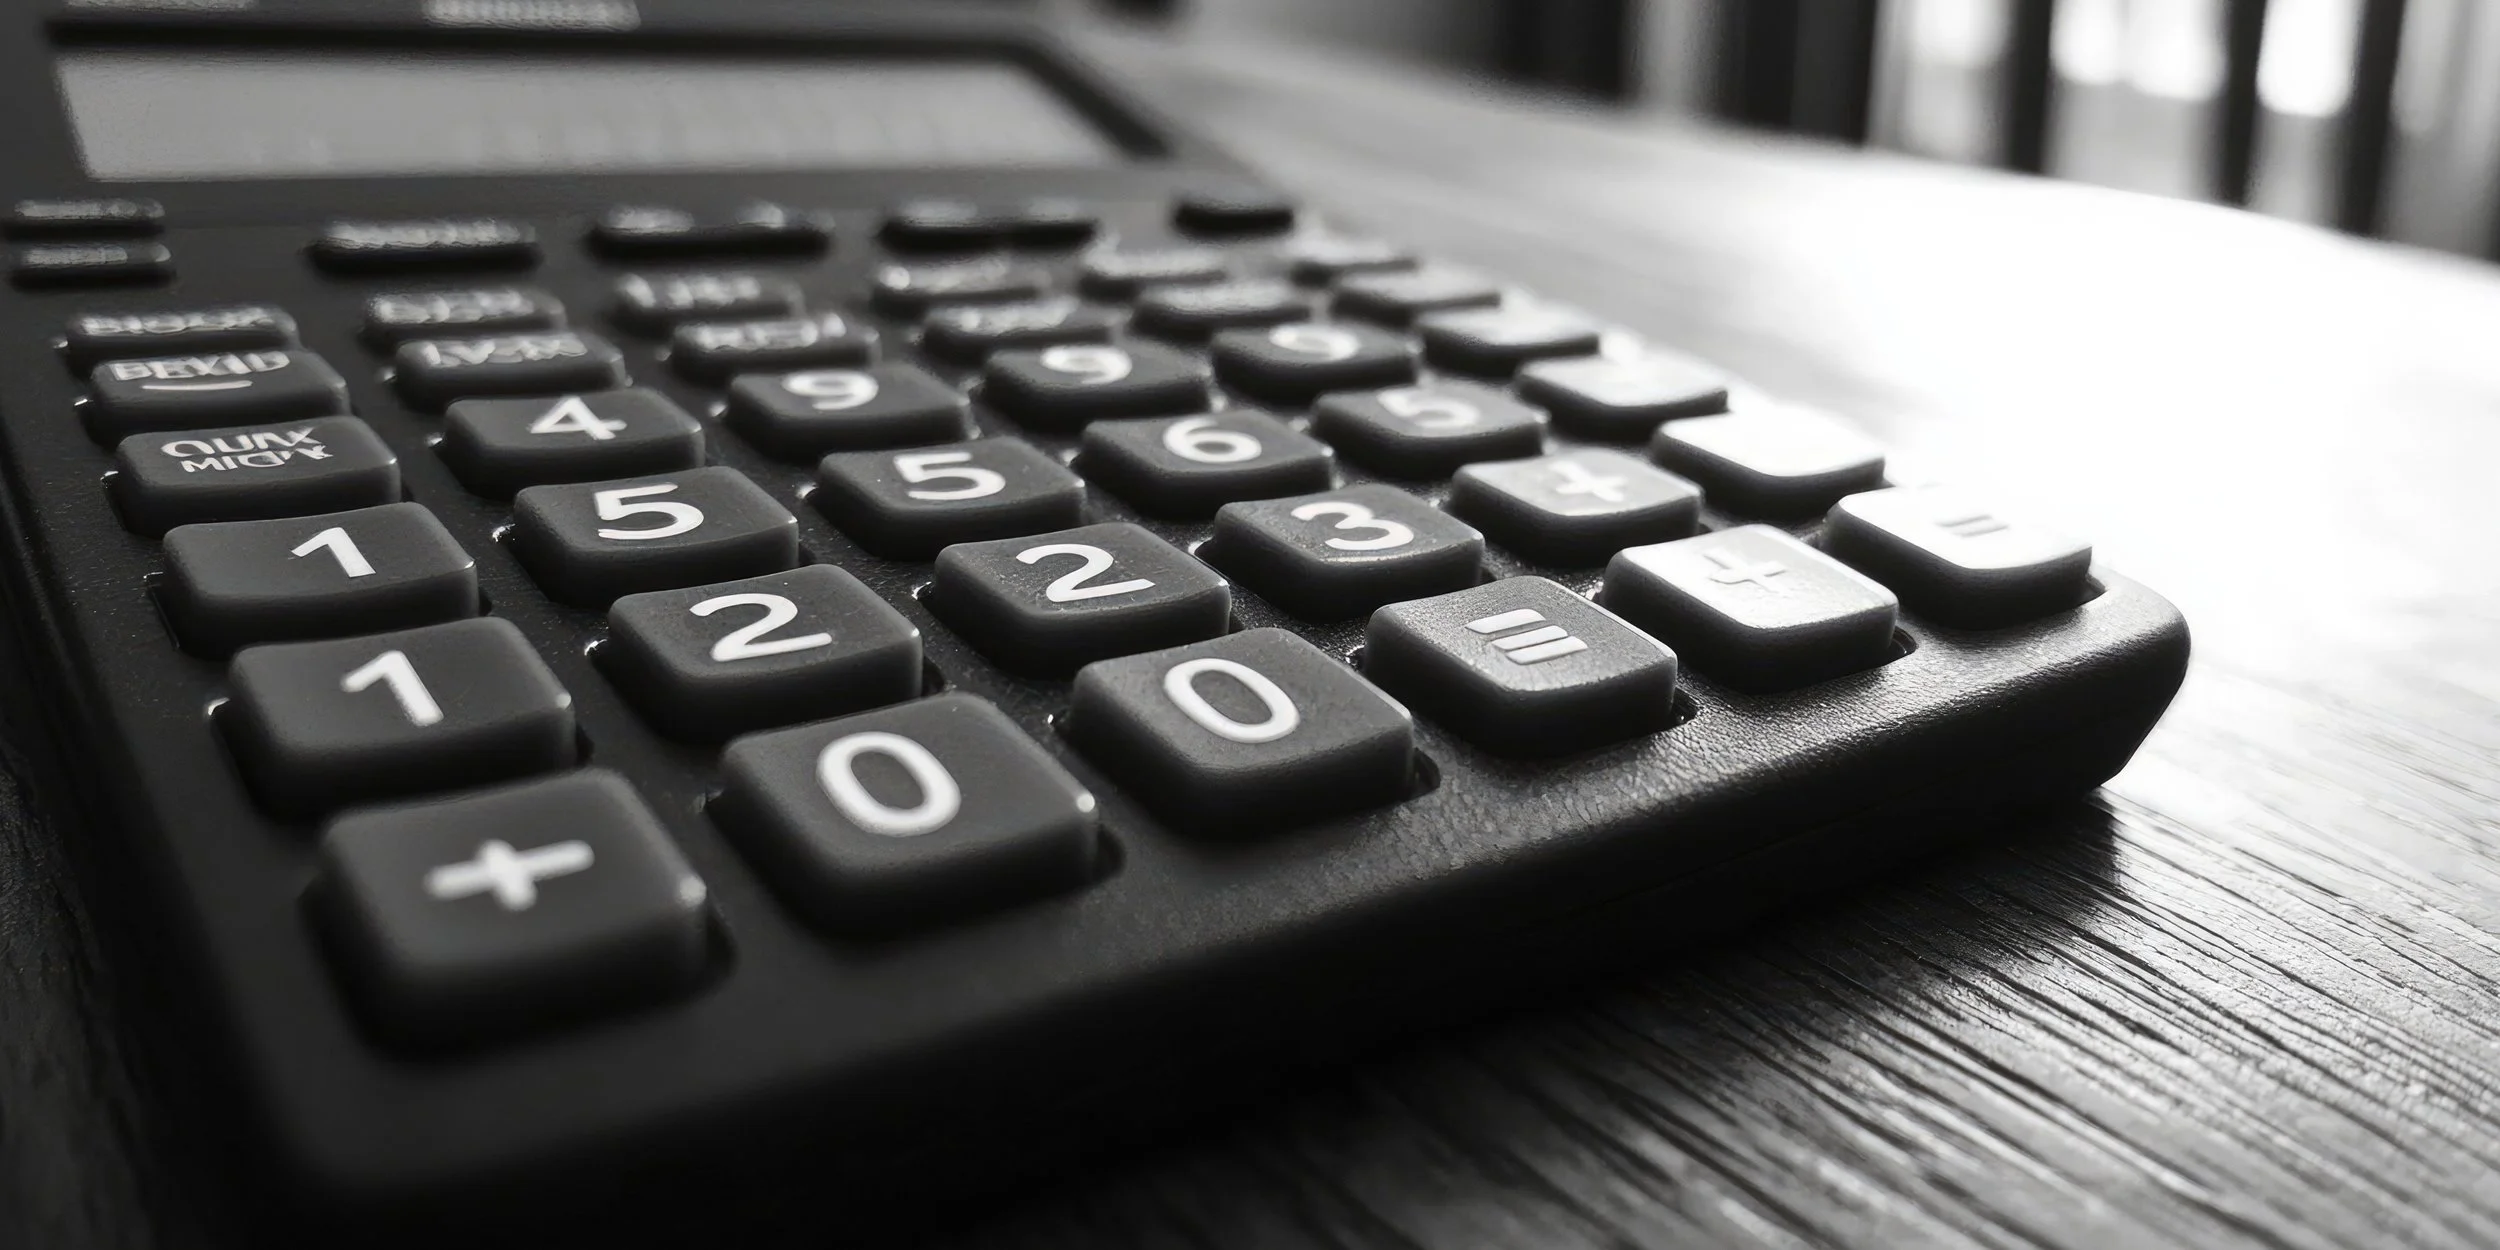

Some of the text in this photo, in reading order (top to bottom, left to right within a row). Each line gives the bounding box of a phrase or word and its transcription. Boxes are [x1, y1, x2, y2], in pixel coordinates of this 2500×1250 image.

[1037, 346, 1134, 386] 9
[1267, 322, 1367, 363] 9
[781, 371, 880, 411] 9
[1376, 386, 1480, 430] 5
[529, 396, 627, 441] 4
[1162, 416, 1263, 464] 6
[893, 451, 1006, 501] 5
[593, 483, 706, 540] 5
[1289, 500, 1415, 552] 3
[290, 526, 377, 578] 1
[1015, 542, 1156, 604] 2
[688, 592, 834, 662] 2
[343, 649, 445, 727] 1
[1163, 657, 1301, 743] 0
[817, 730, 961, 836] 0
